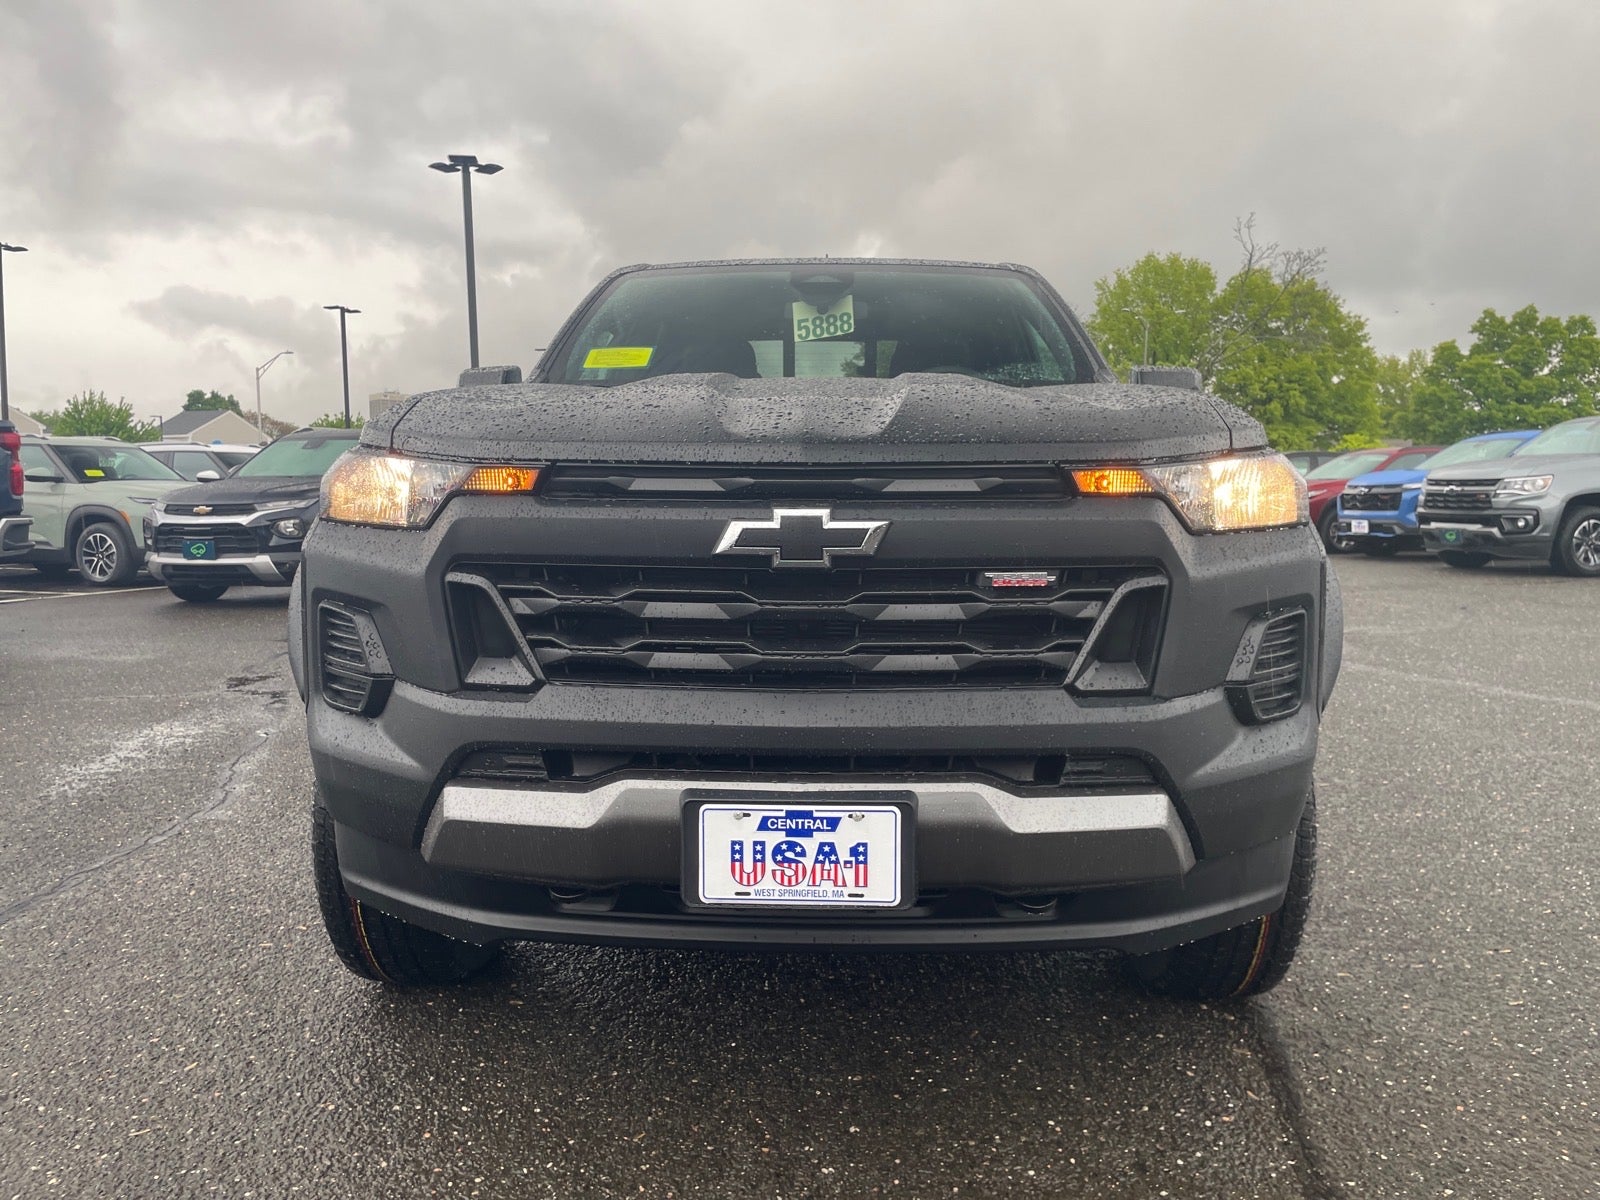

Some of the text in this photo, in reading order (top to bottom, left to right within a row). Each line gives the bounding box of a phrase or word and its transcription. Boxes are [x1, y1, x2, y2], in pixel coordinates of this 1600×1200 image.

[797, 312, 852, 341] 5888
[767, 818, 831, 830] CENTRAL
[730, 840, 868, 888] USA-1
[754, 889, 775, 897] WEST
[832, 890, 845, 898] MA
